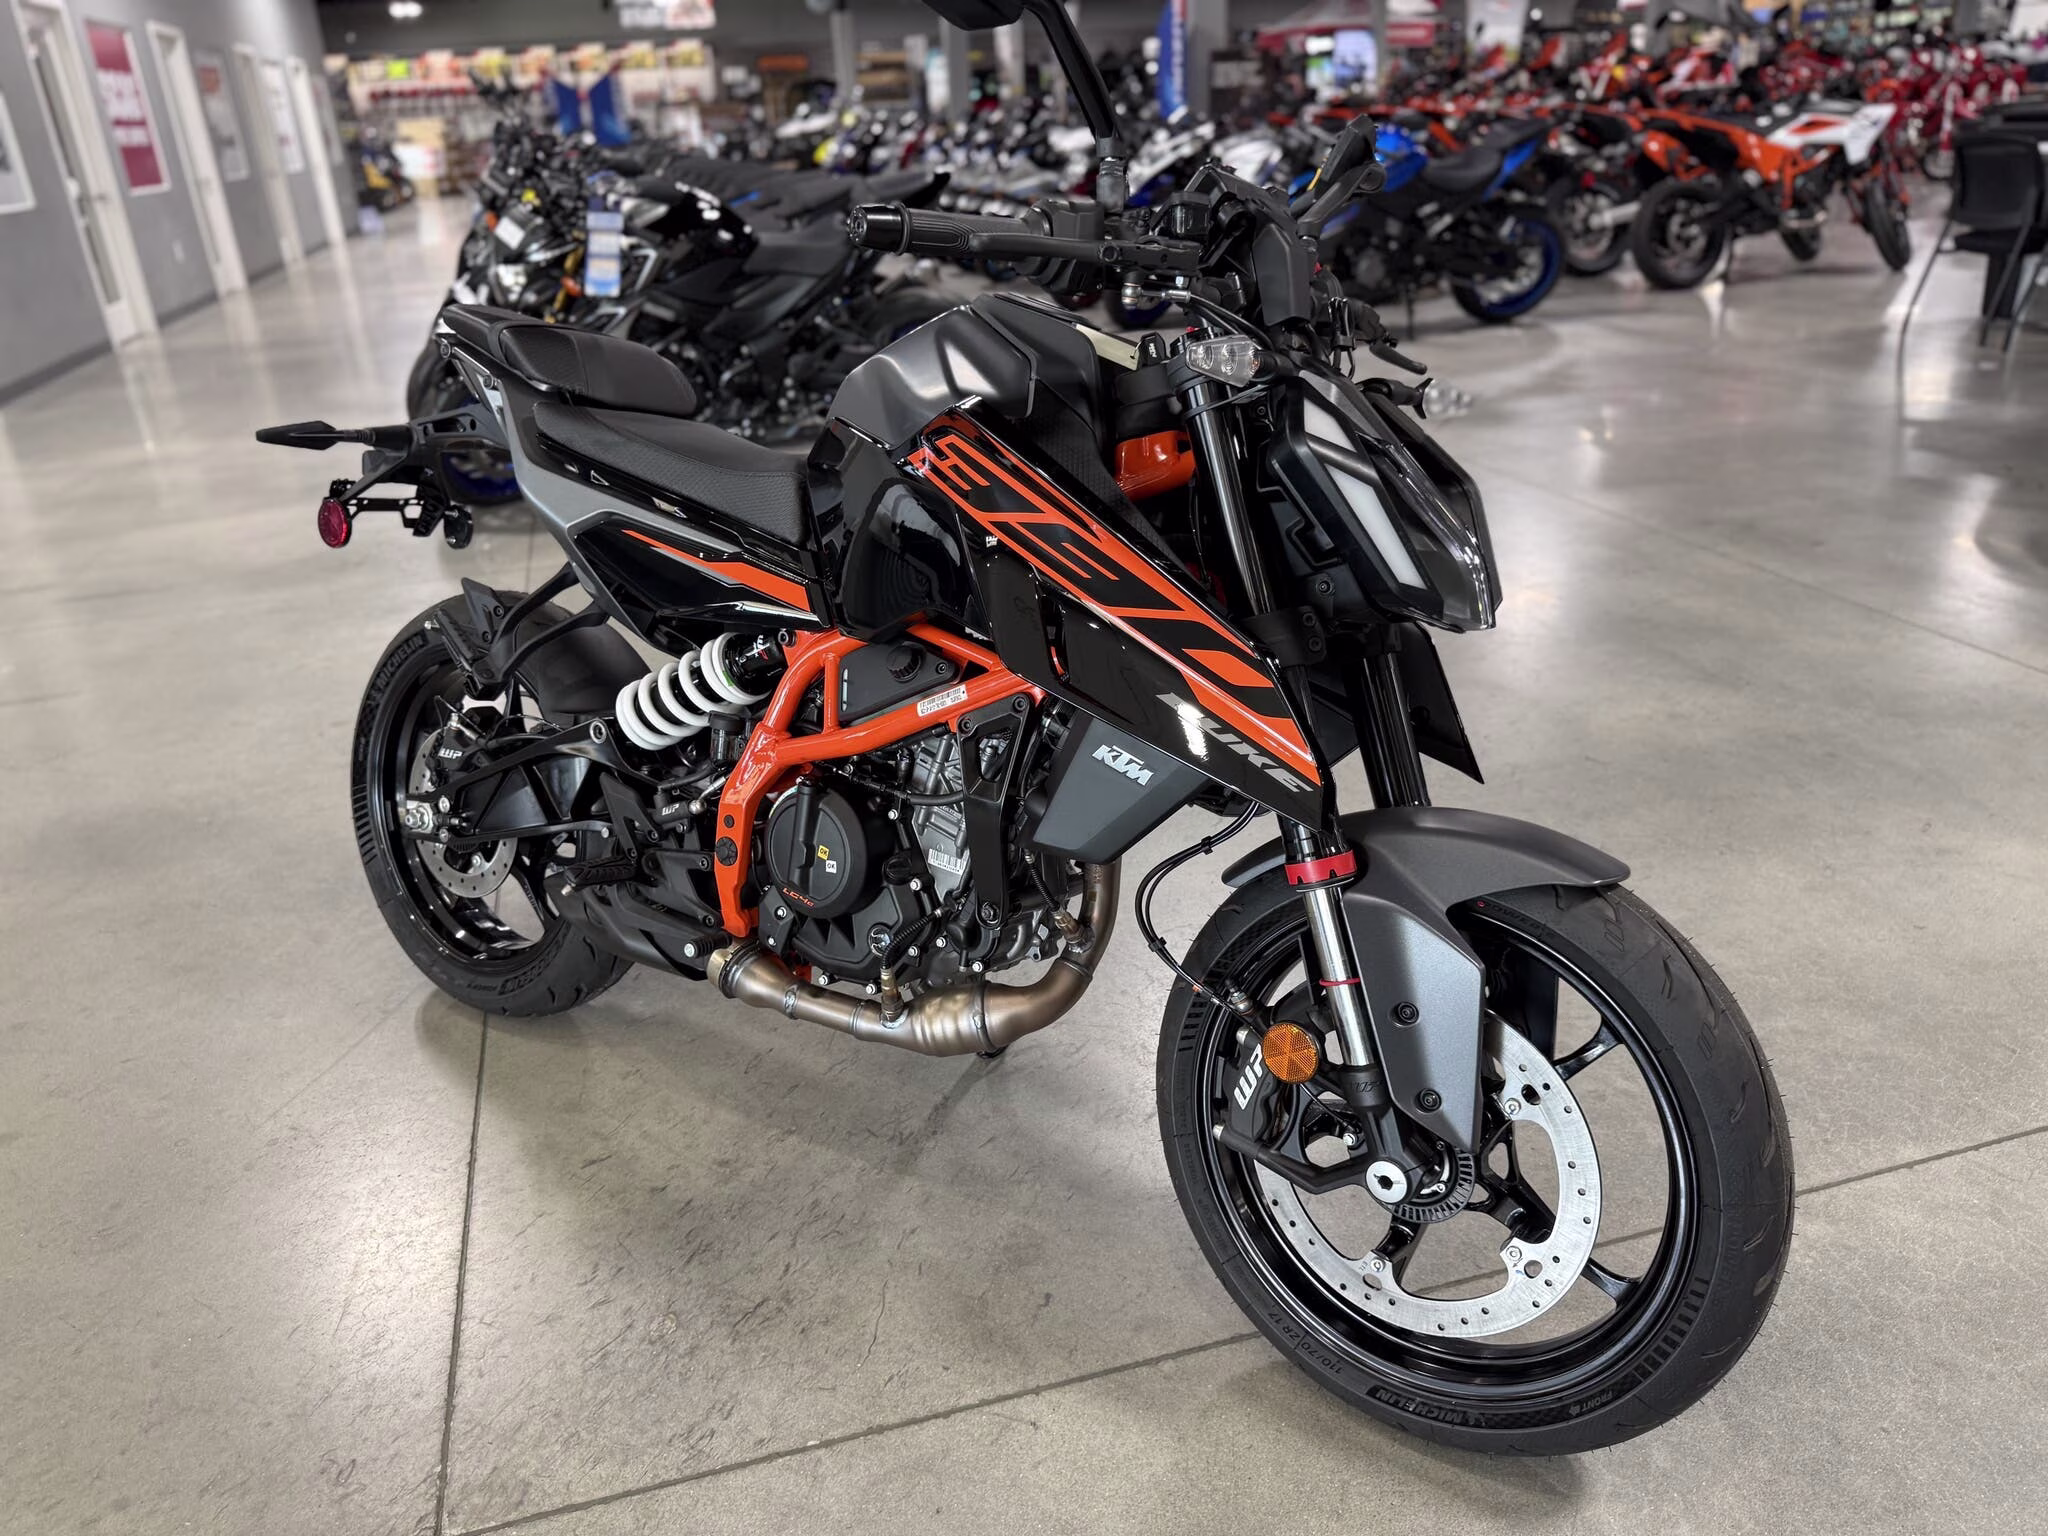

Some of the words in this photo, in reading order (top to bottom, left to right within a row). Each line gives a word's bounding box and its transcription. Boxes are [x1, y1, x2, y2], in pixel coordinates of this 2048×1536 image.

[375, 633, 424, 689] MICHELIN
[438, 748, 463, 760] WP
[1092, 744, 1154, 787] KTM
[1233, 1043, 1263, 1111] WP
[1281, 1324, 1301, 1341] ZR
[1300, 1341, 1345, 1375] 110/70
[1376, 1387, 1465, 1422] MICHELIN
[1581, 1391, 1614, 1414] FRONT
